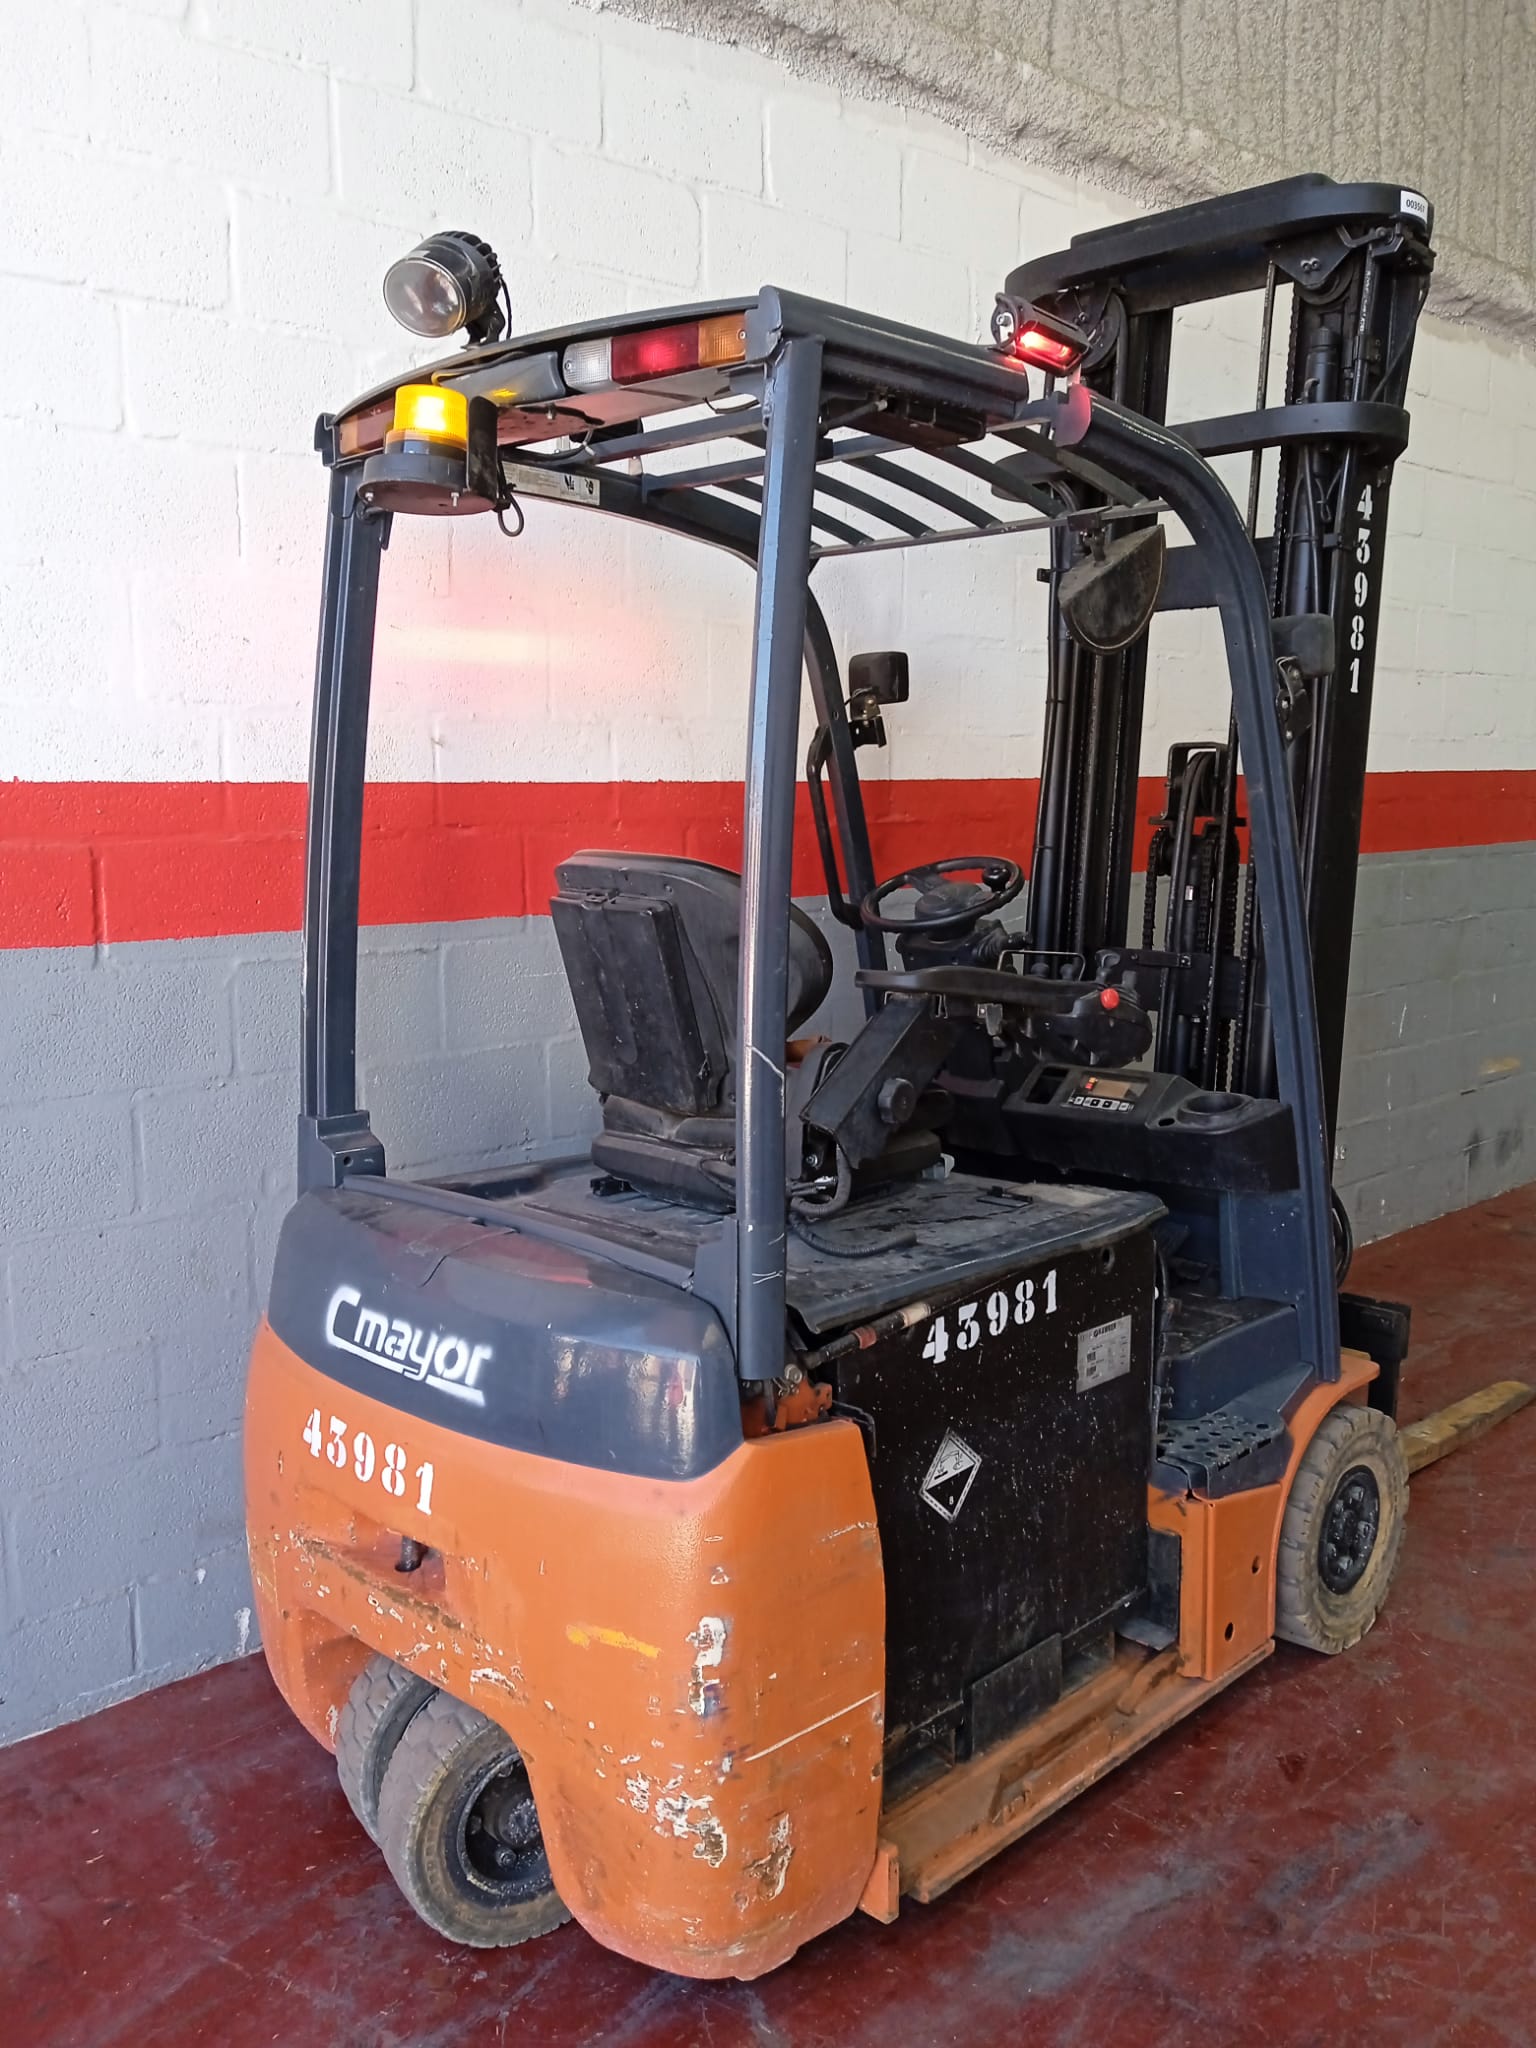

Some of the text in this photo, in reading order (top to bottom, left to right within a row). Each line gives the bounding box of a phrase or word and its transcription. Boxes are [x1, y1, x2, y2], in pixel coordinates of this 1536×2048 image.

[1350, 484, 1373, 693] 43981
[325, 1285, 493, 1405] Cmayor
[922, 1268, 1058, 1364] 43981
[303, 1409, 435, 1516] 43981
